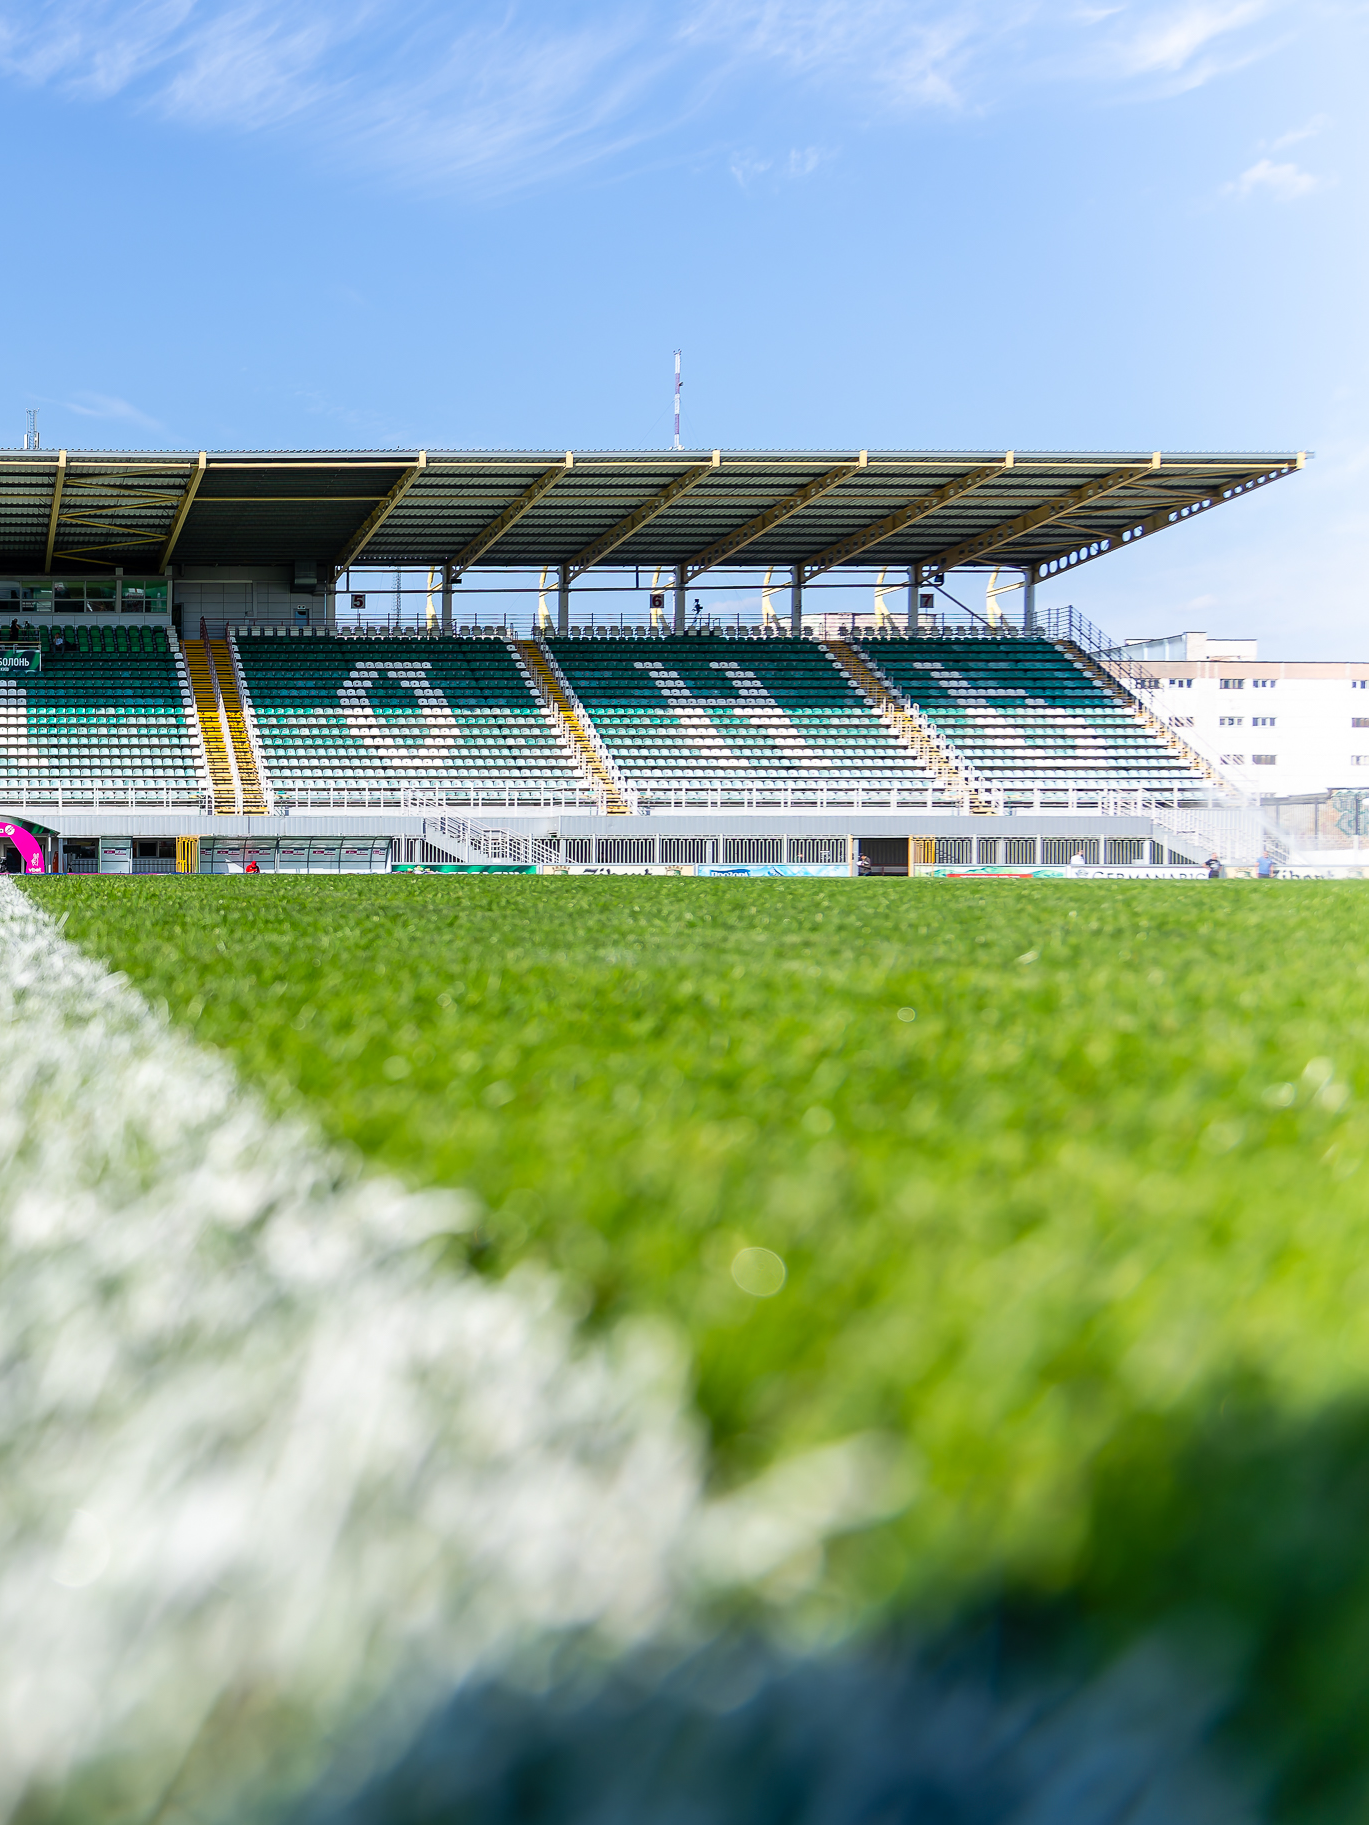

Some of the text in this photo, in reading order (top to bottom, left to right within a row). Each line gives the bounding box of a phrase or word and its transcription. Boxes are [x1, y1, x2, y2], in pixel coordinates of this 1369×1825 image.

[353, 594, 364, 608] 5
[652, 595, 663, 607] 6
[922, 595, 932, 607] 7
